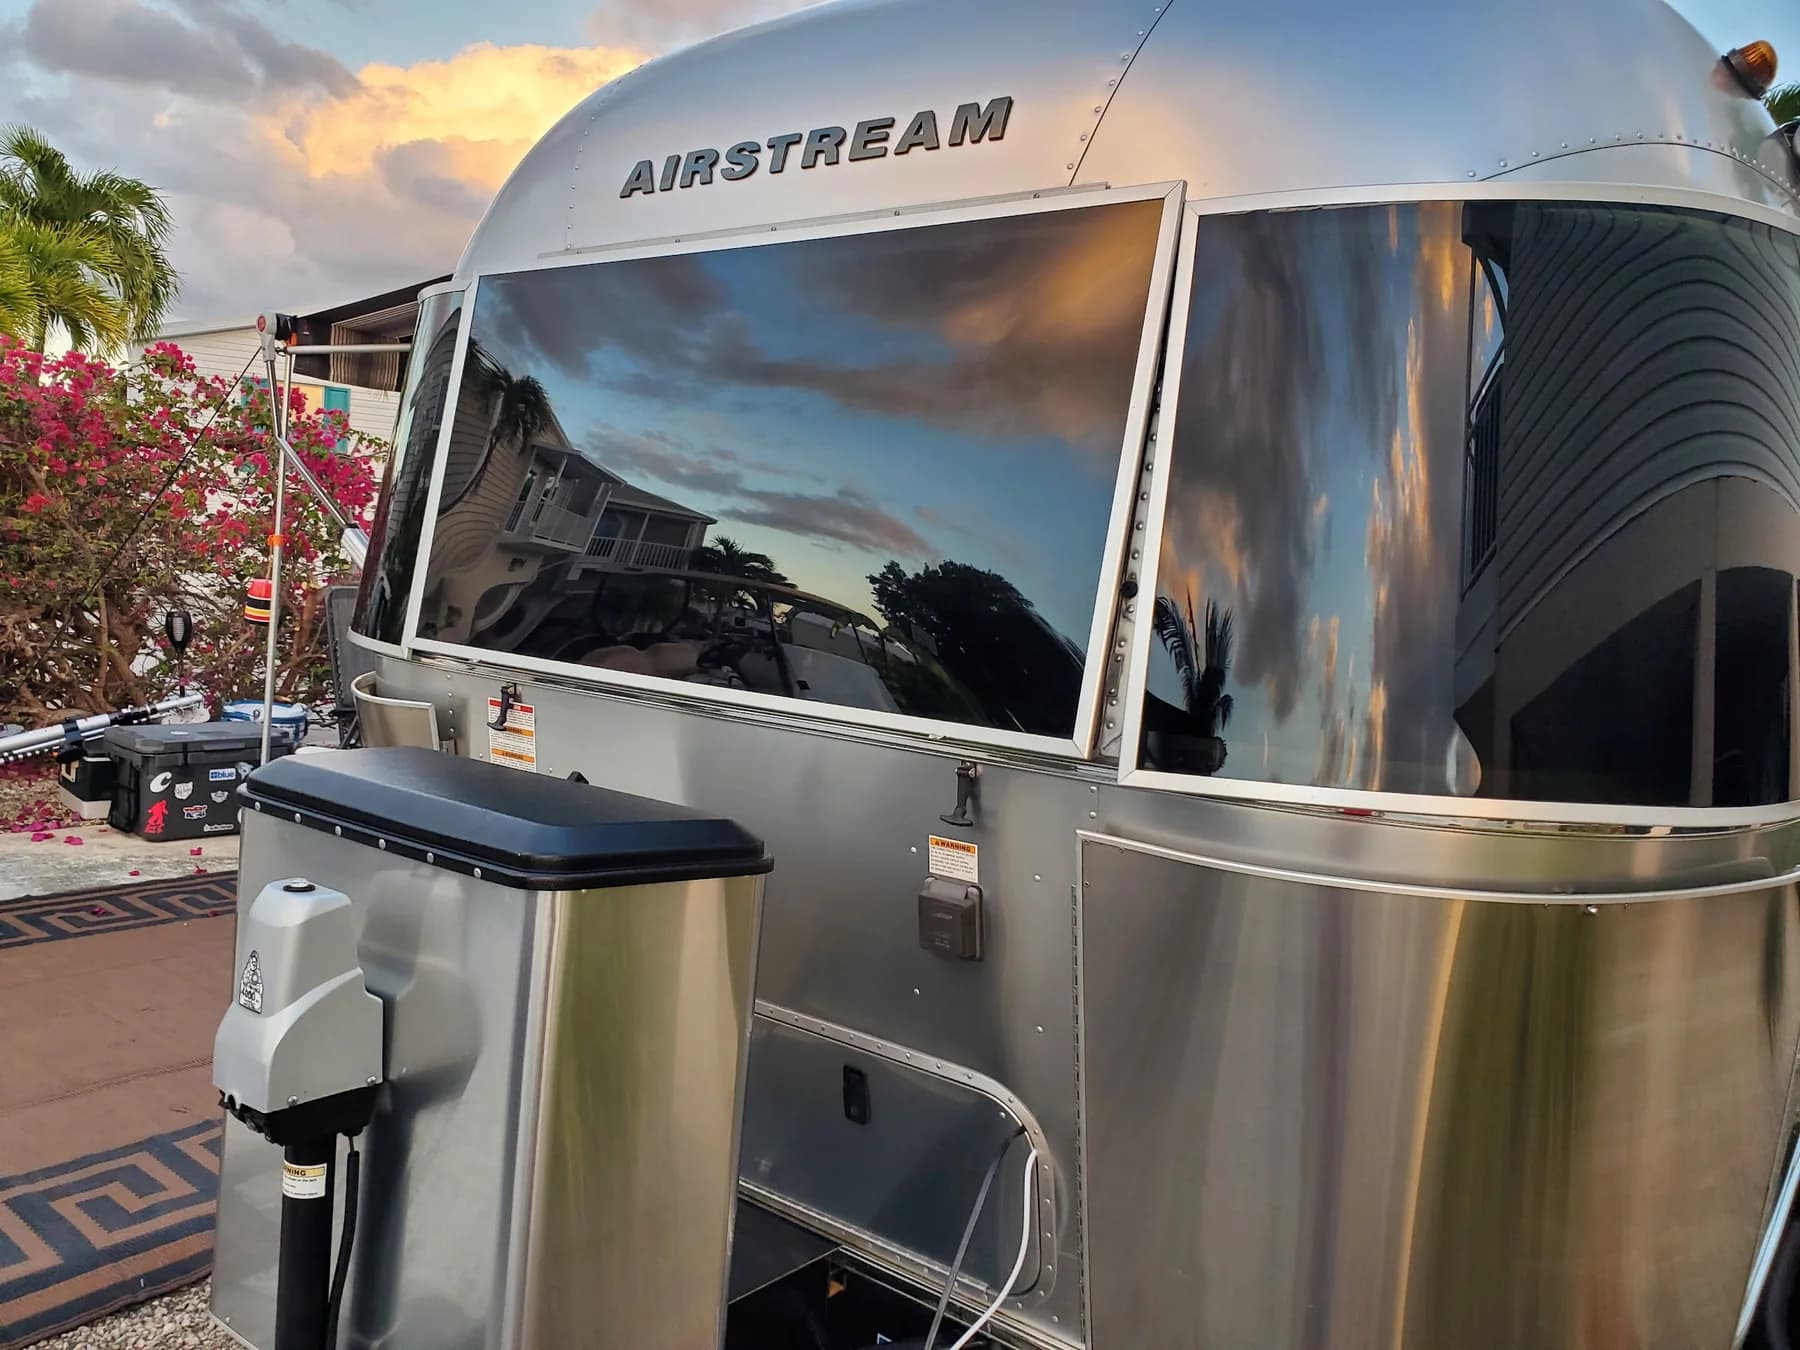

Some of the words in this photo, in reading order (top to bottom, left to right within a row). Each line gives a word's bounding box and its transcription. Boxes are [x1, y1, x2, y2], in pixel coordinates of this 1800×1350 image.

[619, 95, 1013, 199] AIRSTREAM
[218, 771, 234, 779] blue
[940, 840, 971, 853] WARNING
